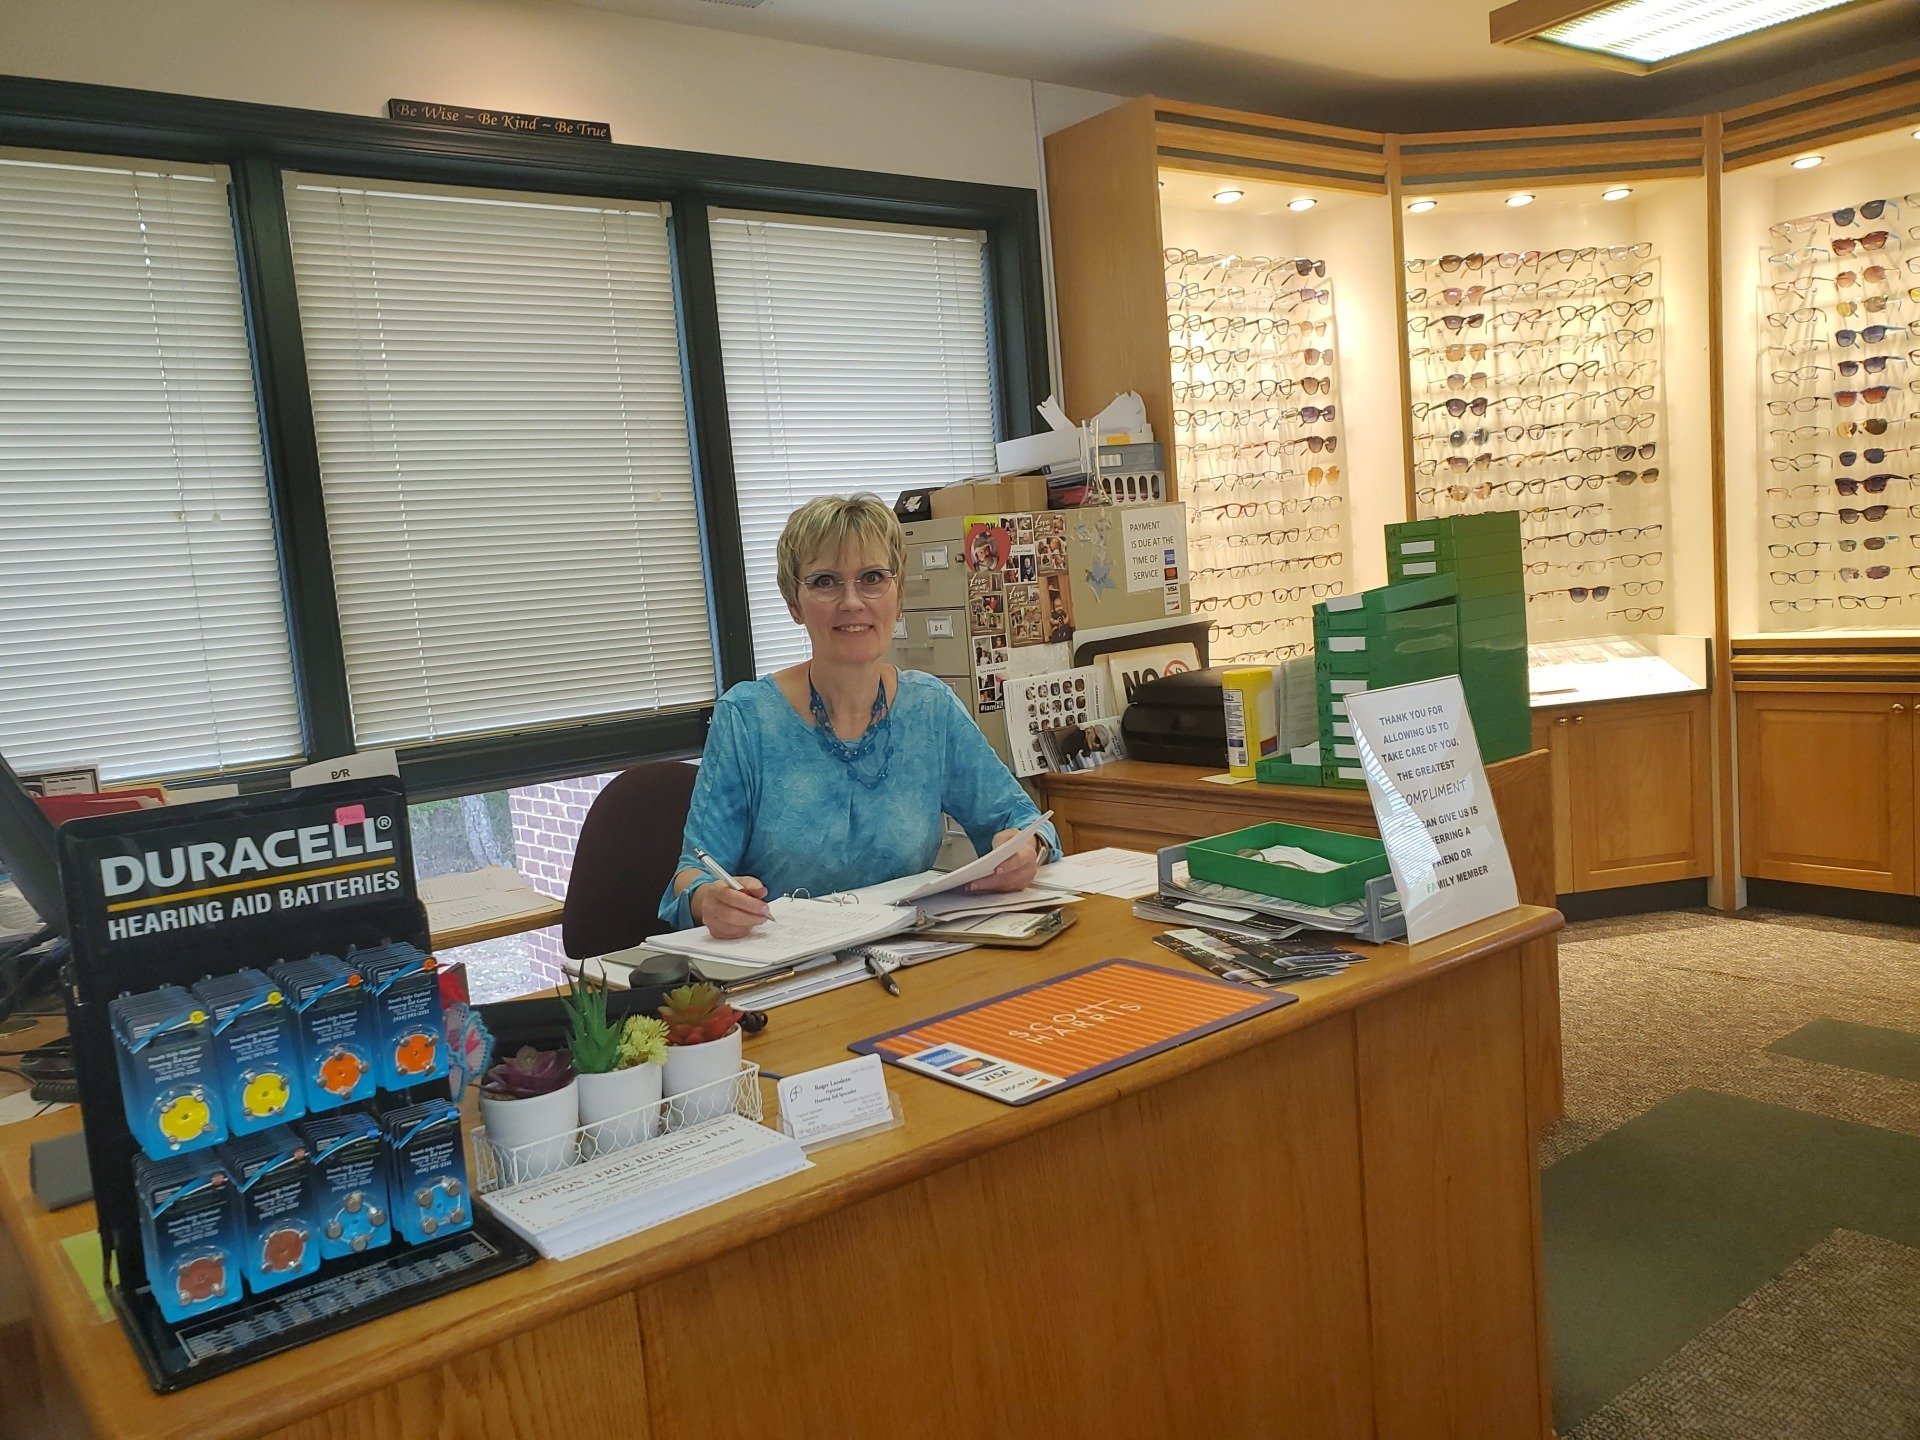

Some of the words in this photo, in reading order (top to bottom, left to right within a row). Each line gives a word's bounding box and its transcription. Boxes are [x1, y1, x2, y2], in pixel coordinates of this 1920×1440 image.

[396, 104, 418, 117] Be
[422, 105, 459, 122] Wise
[478, 112, 498, 126] Be
[502, 116, 539, 131] Kind
[554, 121, 574, 134] Be
[577, 124, 607, 138] True
[1129, 521, 1160, 532] PAYMENT
[1131, 540, 1137, 549] IS
[1138, 539, 1151, 547] DUE
[1153, 537, 1161, 546] AT
[1162, 536, 1174, 544] THE
[1132, 556, 1148, 565] TIME
[1149, 554, 1158, 563] OF
[969, 572, 987, 587] Love
[1133, 570, 1159, 580] SERVICE
[1009, 586, 1026, 599] Love
[1379, 712, 1409, 727] THANK
[1409, 709, 1426, 720] YOU
[1427, 705, 1444, 716] FOR
[1383, 727, 1425, 744] ALLOWING
[1426, 724, 1437, 734] US
[1437, 722, 1450, 732] TO
[1381, 751, 1405, 764] TAKE
[1405, 744, 1427, 757] CARE
[1428, 742, 1438, 752] OF
[1440, 738, 1460, 750] YOU.
[1396, 770, 1414, 782] THE
[1415, 760, 1455, 777] GREATEST
[1403, 780, 1466, 806] OMPLIMENT
[1438, 812, 1457, 825] GIVE
[1458, 808, 1469, 819] US
[1469, 805, 1479, 815] IS
[1465, 827, 1471, 836] A
[99, 817, 393, 897] DURACELL
[1461, 848, 1473, 859] OR
[1426, 876, 1455, 893] FAMILY
[1456, 865, 1489, 884] MEMBER
[107, 901, 224, 941] HEARING
[231, 892, 272, 918] AID
[278, 870, 401, 910] BATTERIES
[1008, 999, 1114, 1038] SCOTT
[1026, 1003, 1141, 1044] HARRIS
[977, 1069, 1015, 1082] VISA
[519, 1180, 584, 1205] COUPON
[595, 1161, 635, 1179] FREE
[635, 1139, 702, 1163] HEARING
[704, 1125, 736, 1140] TEST
